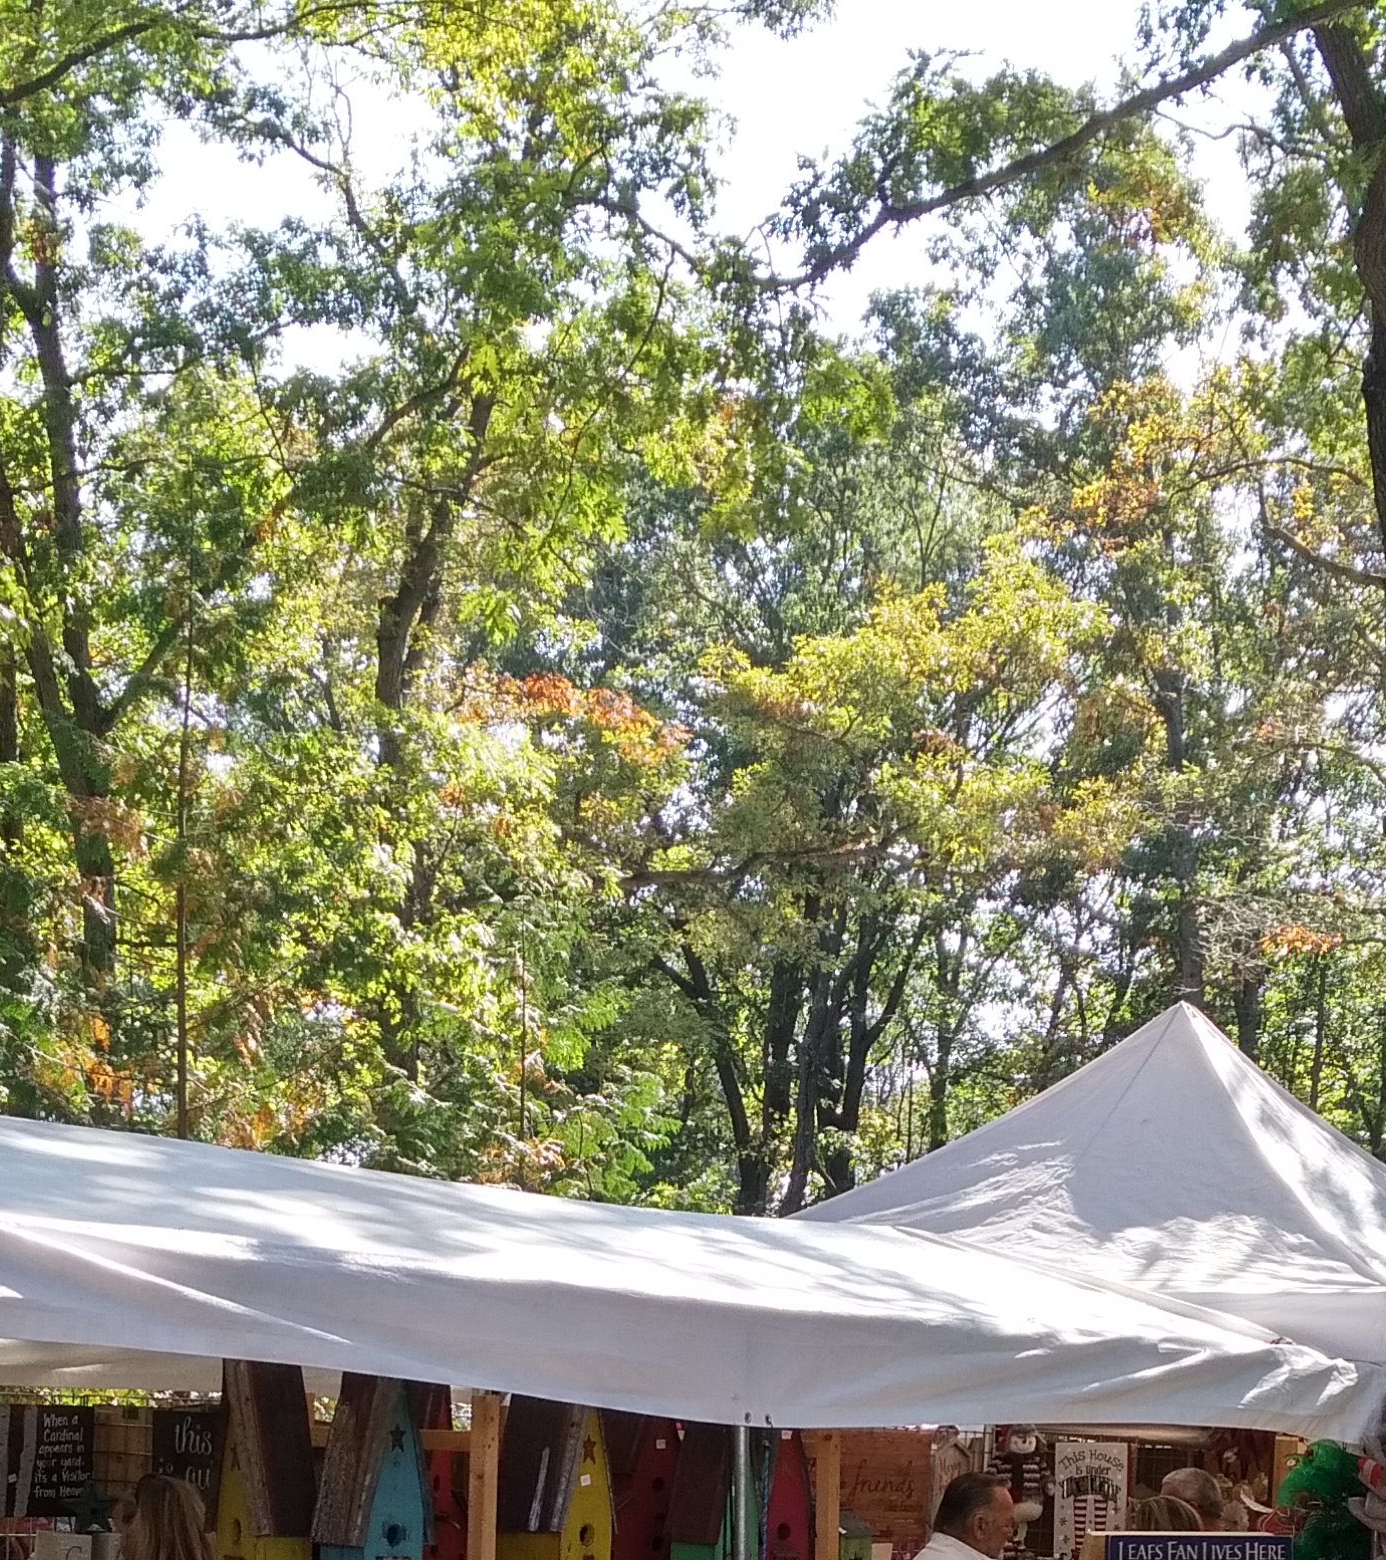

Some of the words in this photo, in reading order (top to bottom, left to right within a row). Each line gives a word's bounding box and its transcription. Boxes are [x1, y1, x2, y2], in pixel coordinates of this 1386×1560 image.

[43, 1412, 69, 1427] When
[72, 1414, 79, 1426] a
[43, 1427, 84, 1443] Cardinal
[174, 1416, 213, 1456] this
[38, 1443, 73, 1458] appears
[75, 1443, 85, 1453] in
[1058, 1450, 1086, 1470] This
[1089, 1449, 1125, 1472] House
[51, 1473, 58, 1483] a
[32, 1485, 56, 1499] from
